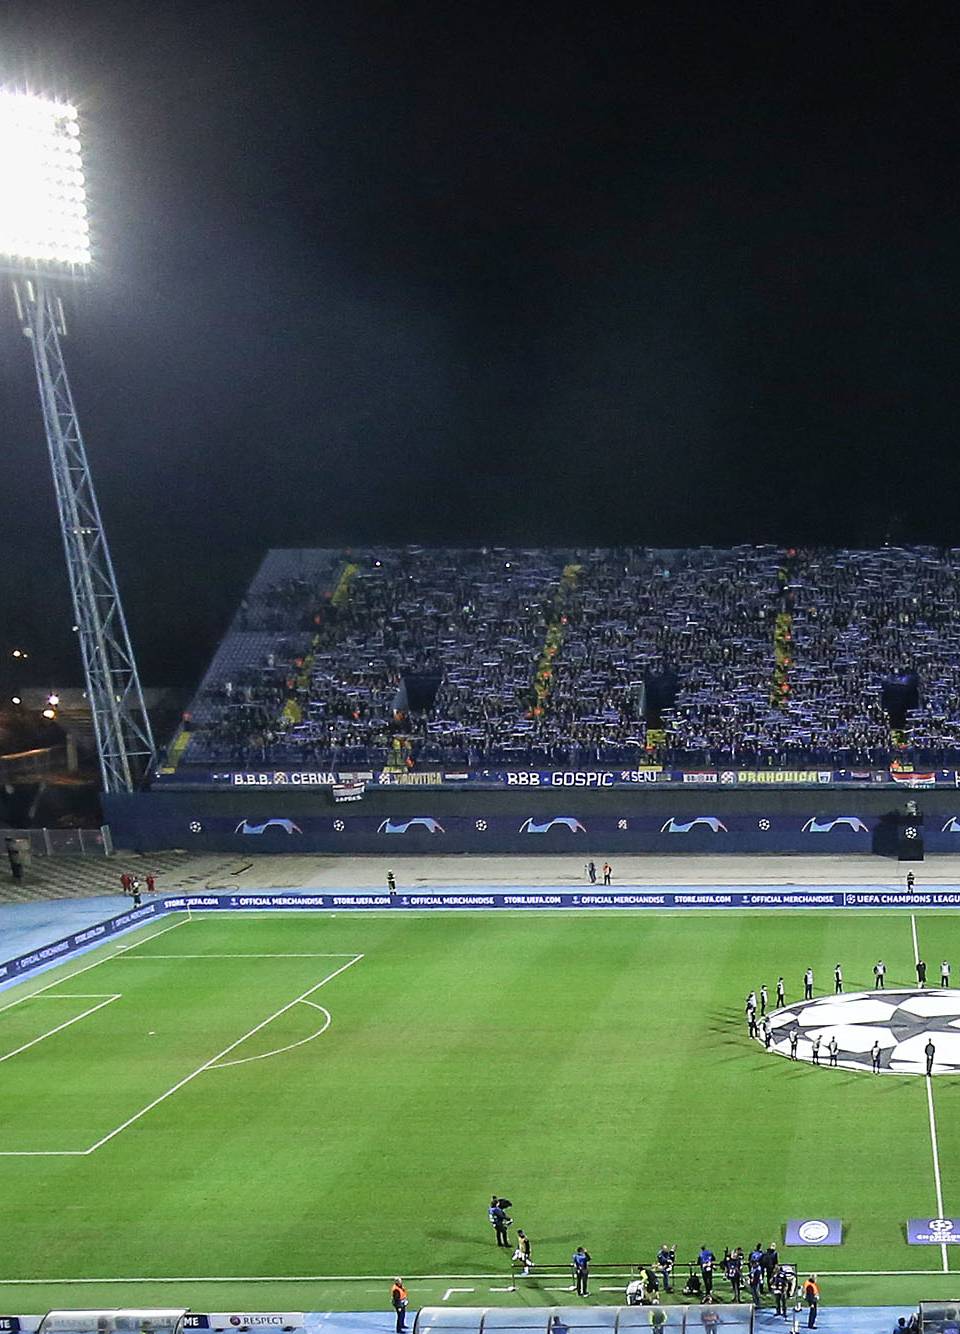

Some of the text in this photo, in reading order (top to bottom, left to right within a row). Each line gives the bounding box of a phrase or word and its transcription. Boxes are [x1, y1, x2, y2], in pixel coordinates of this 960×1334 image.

[291, 772, 336, 785] CERNA
[507, 772, 540, 785] BBB
[333, 896, 391, 904] STORE.UEFA.COM
[411, 896, 495, 904] OFFICIAL MERCHANDISE
[581, 895, 664, 904] OFFICIAL MERCHANDISE
[674, 895, 731, 903] STORE.UEFA.COM
[751, 895, 834, 903] OFFICIAL MERCHANDISE
[857, 895, 880, 903] UEFA
[881, 895, 930, 903] CHAMPIONS
[243, 1316, 284, 1325] RESPECT
